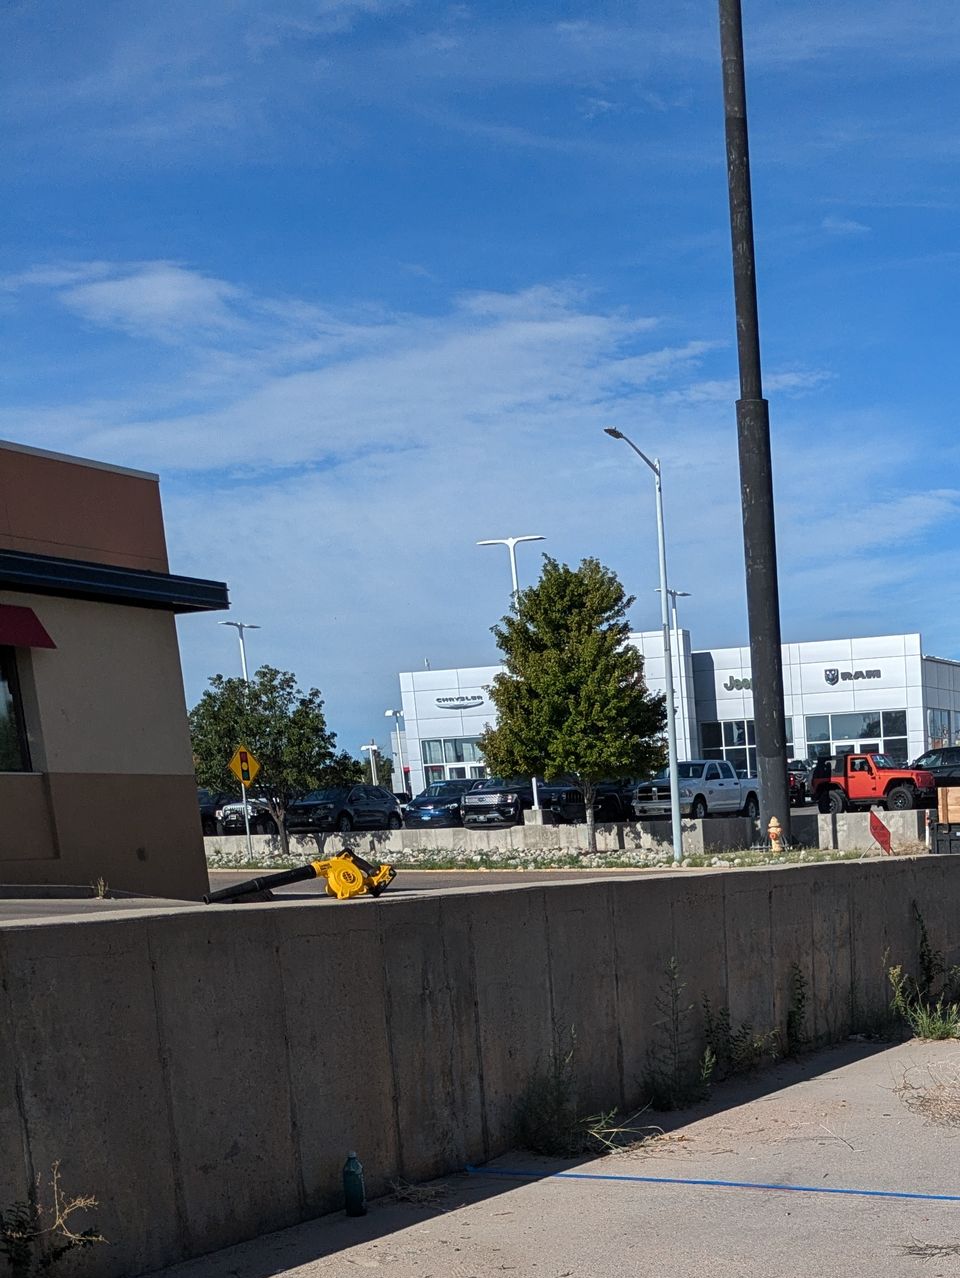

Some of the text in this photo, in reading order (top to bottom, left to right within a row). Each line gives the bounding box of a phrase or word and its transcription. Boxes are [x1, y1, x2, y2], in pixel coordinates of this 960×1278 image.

[840, 669, 881, 680] RAM
[724, 676, 753, 691] Jee
[436, 695, 483, 703] CHRYSLER
